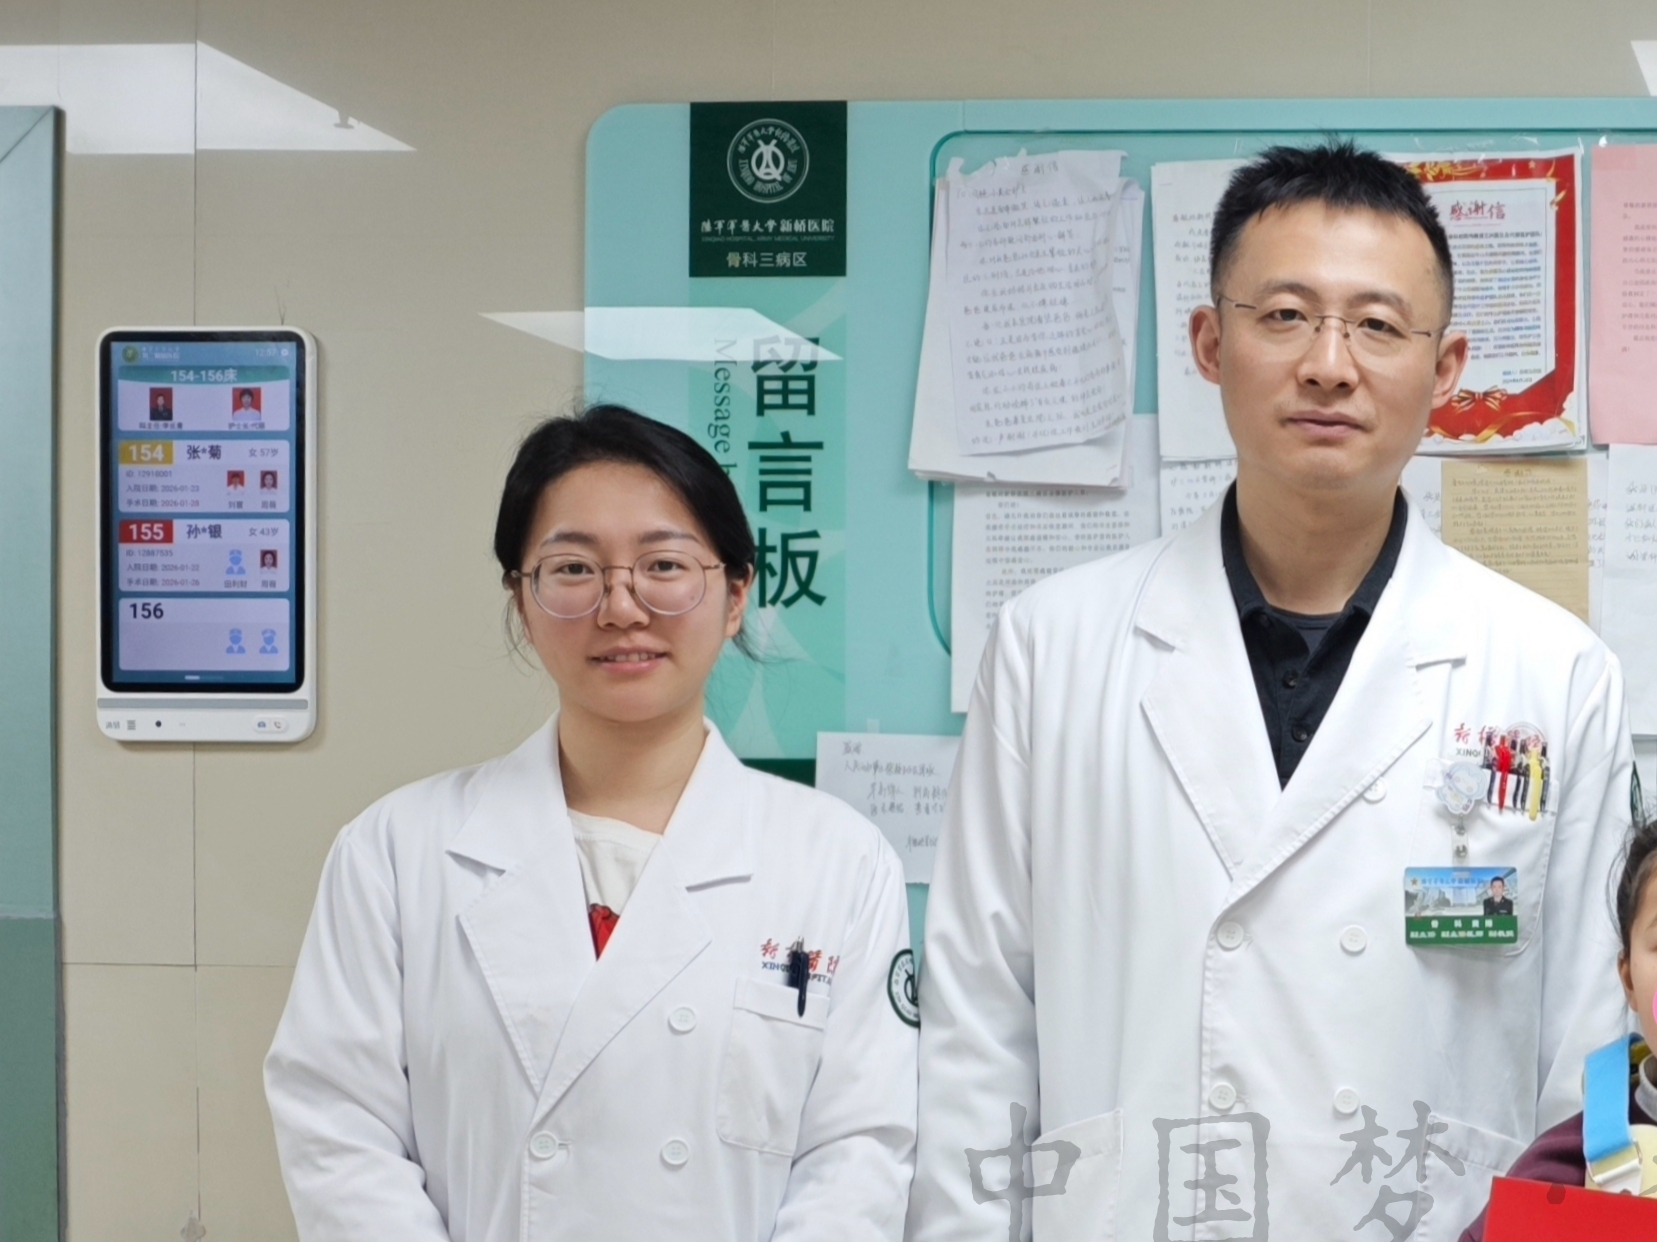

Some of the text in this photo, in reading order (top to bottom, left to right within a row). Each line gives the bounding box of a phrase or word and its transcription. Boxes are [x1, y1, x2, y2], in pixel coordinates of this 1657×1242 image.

[1450, 201, 1506, 221] 感谢信
[726, 251, 807, 268] 骨科三病区
[170, 369, 238, 383] 154-156床
[707, 337, 738, 453] Message
[129, 444, 164, 462] 154
[748, 336, 827, 609] 留言板
[129, 523, 164, 540] 155
[129, 602, 164, 619] 156
